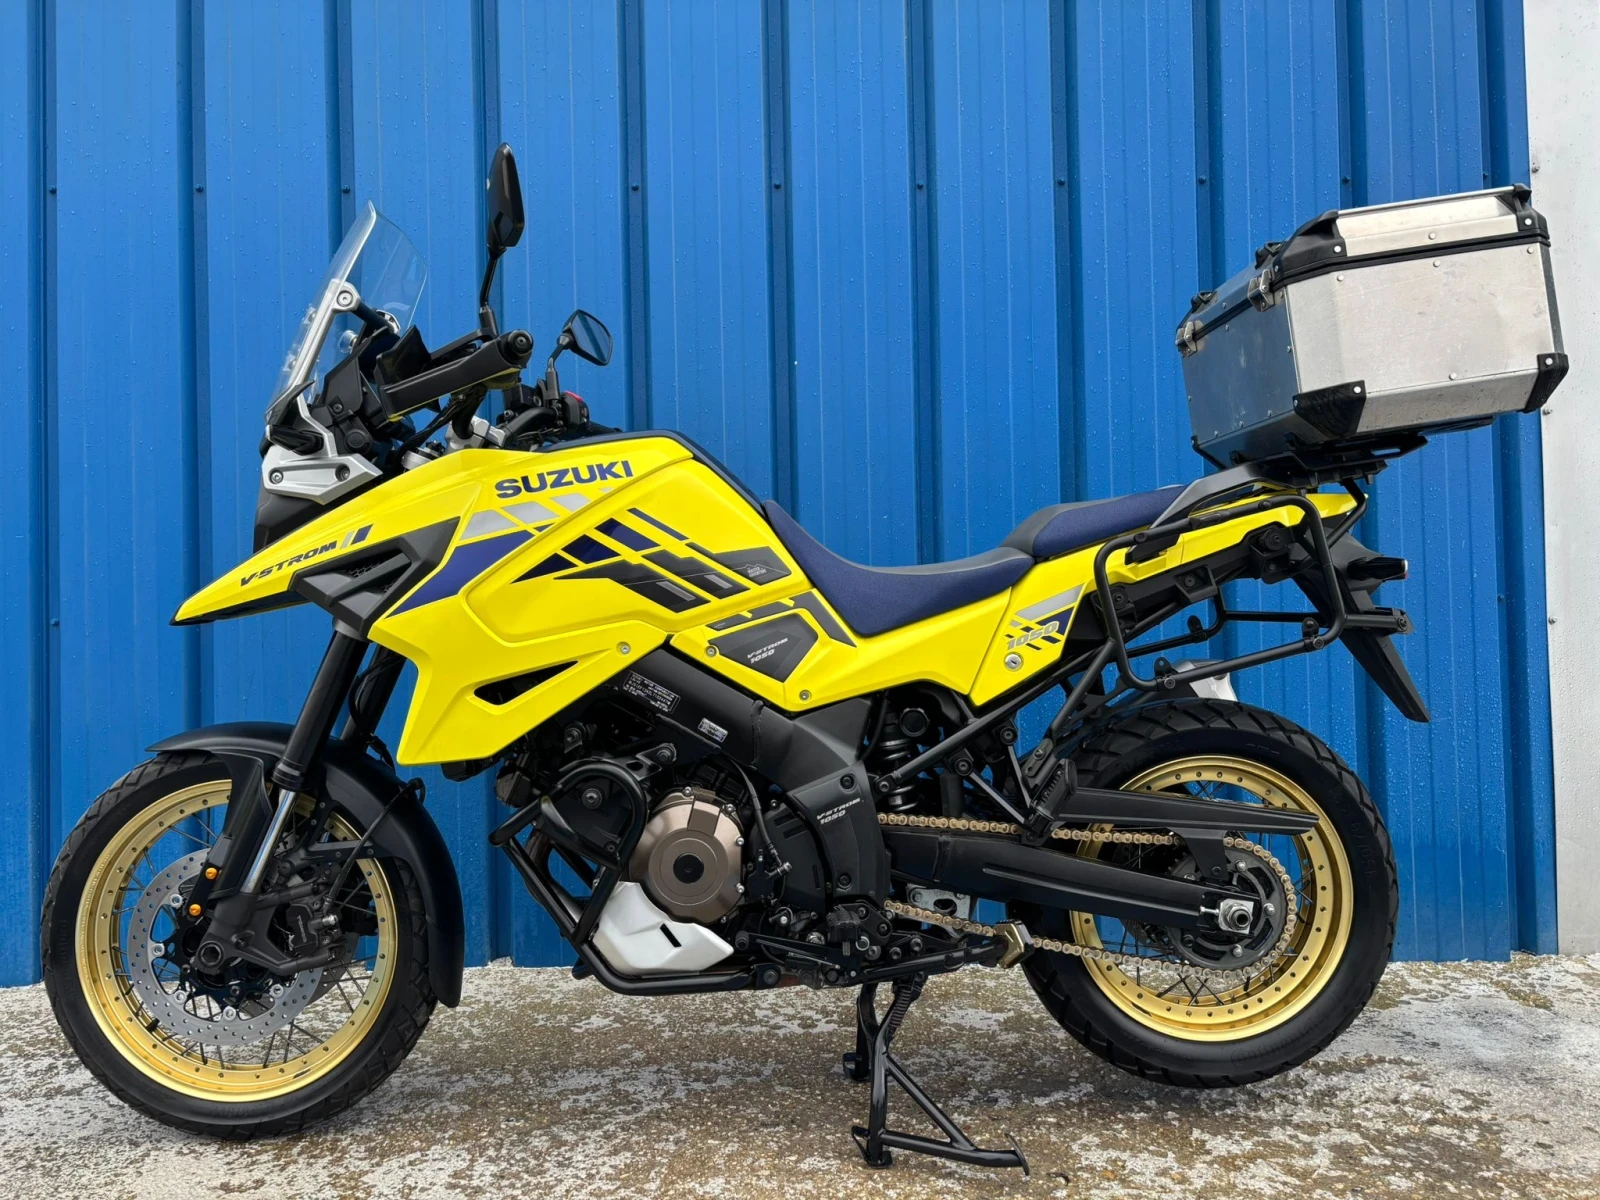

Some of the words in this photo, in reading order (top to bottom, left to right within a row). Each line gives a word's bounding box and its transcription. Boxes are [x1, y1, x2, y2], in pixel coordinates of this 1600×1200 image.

[494, 460, 634, 499] SUZUKI
[240, 540, 338, 587] V-STROM
[1006, 620, 1060, 651] 1050
[750, 648, 775, 664] 1050
[820, 809, 846, 825] 1050
